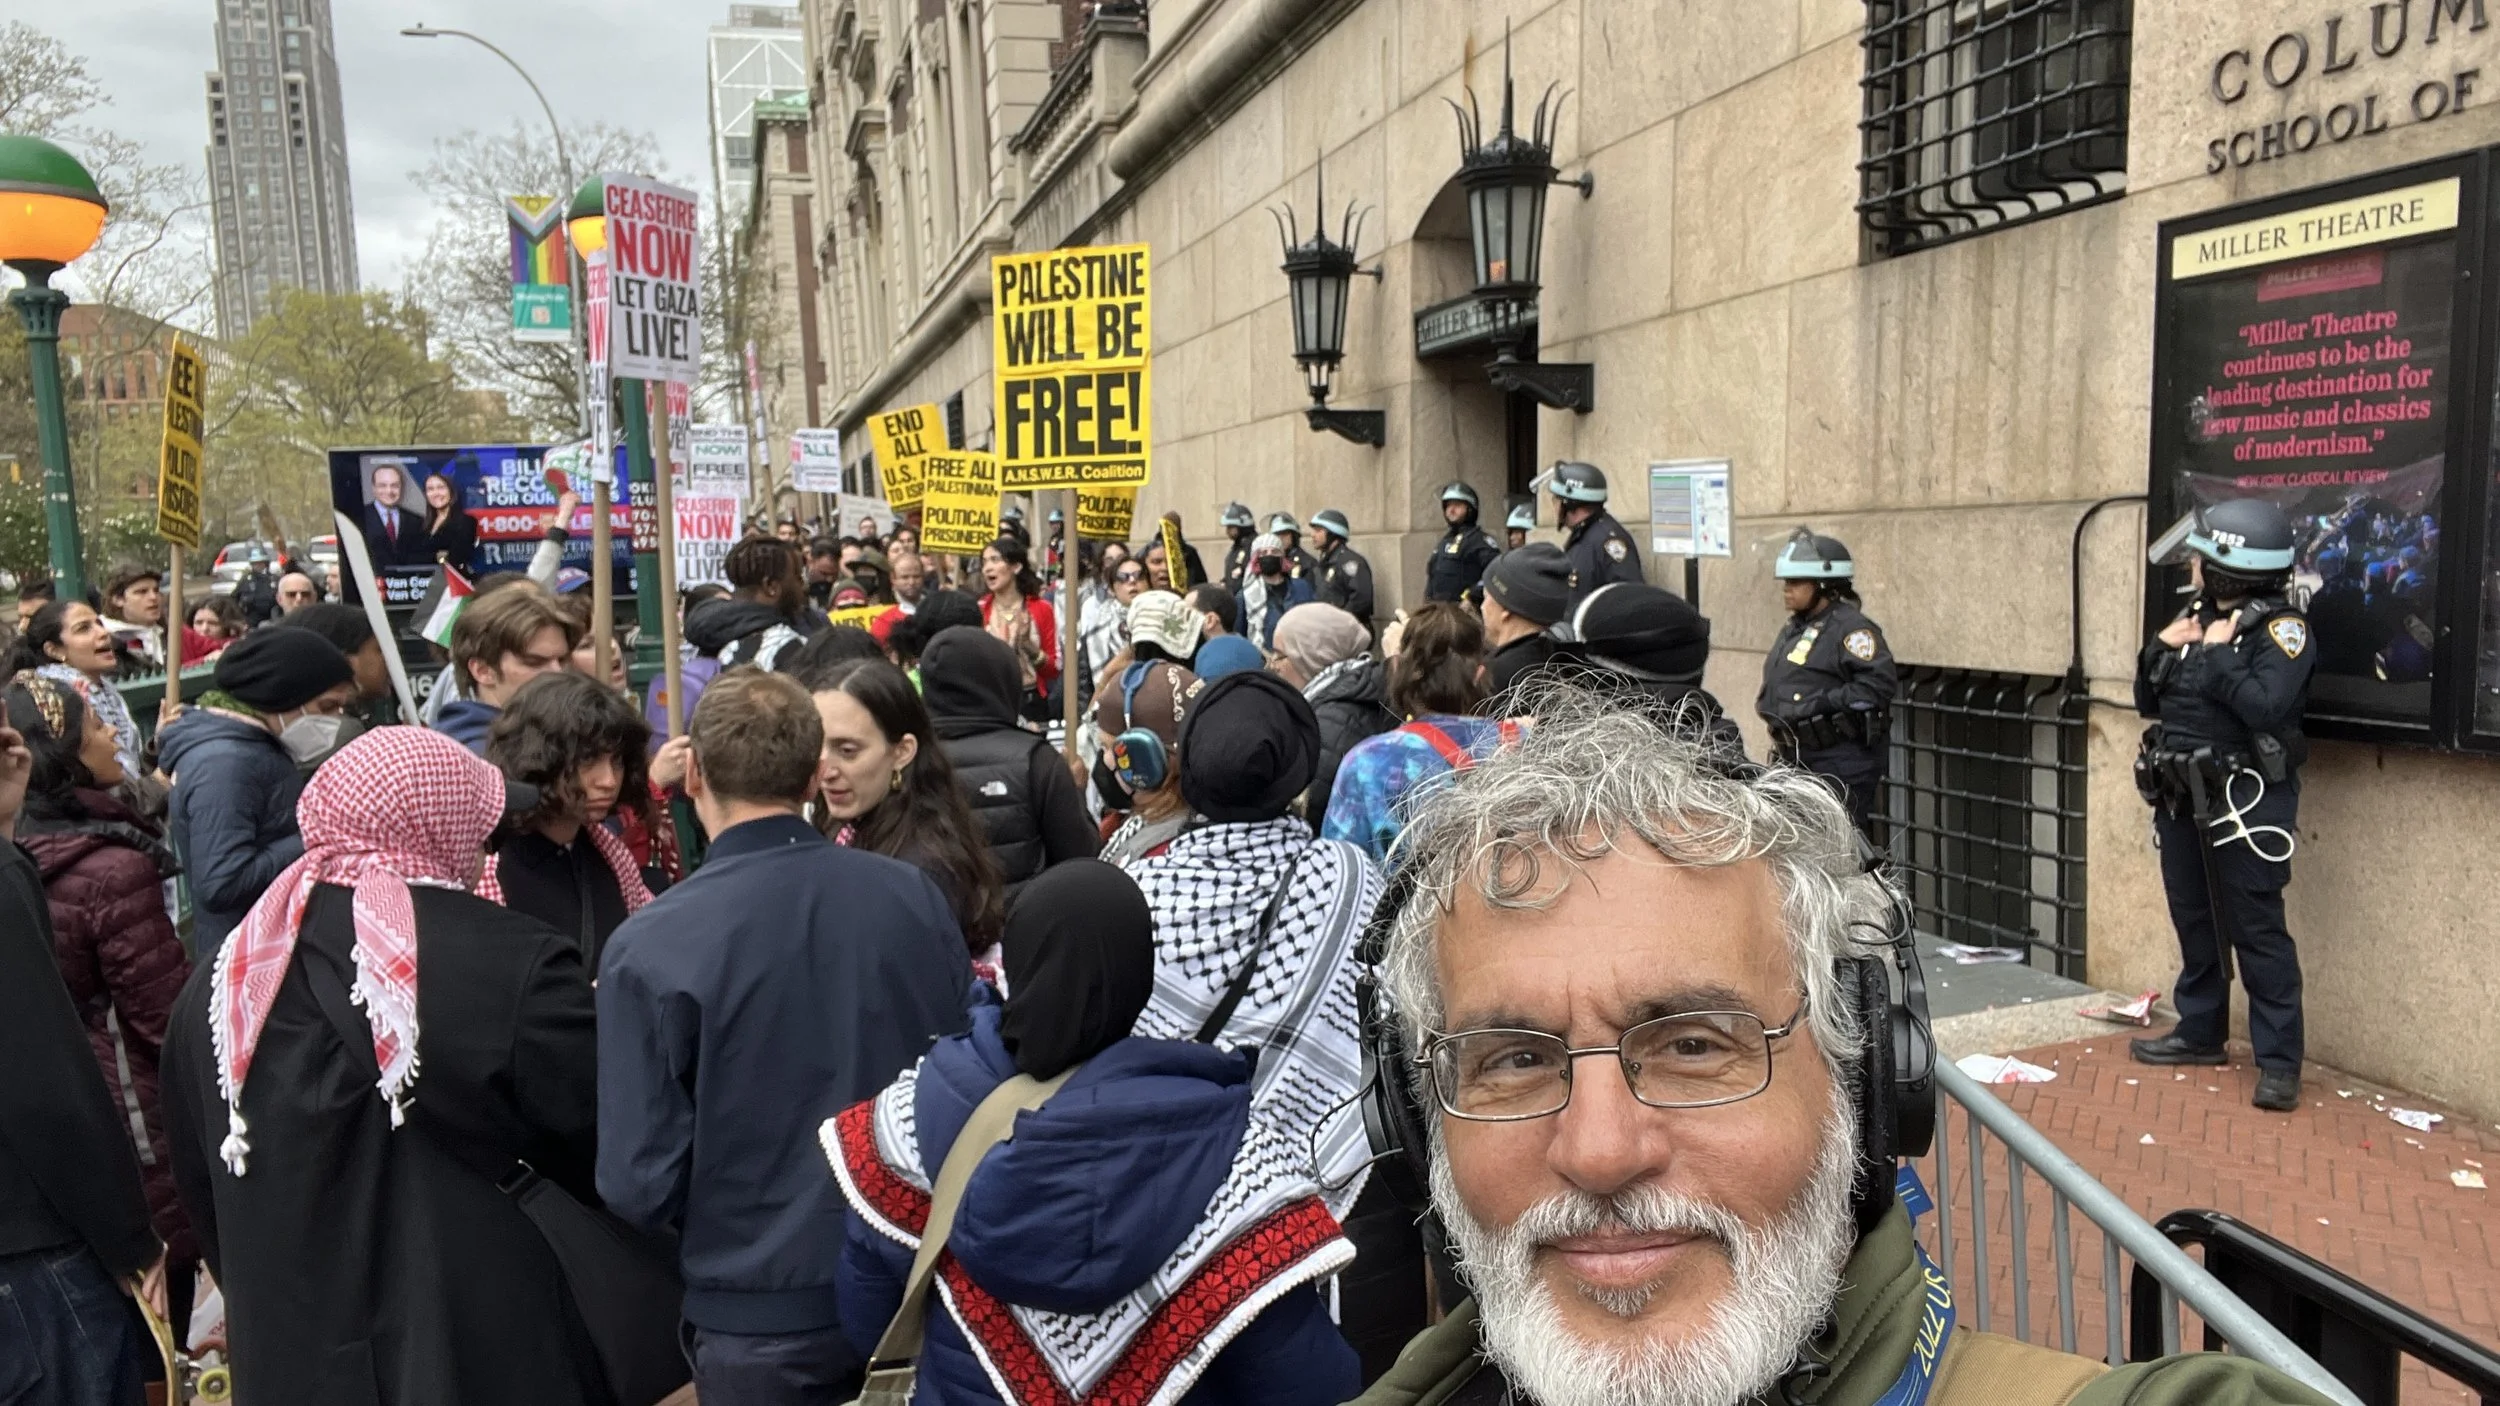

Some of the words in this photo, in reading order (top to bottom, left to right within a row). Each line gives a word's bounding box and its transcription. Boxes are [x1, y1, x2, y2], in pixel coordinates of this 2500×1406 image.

[2211, 0, 2489, 106] COLUM
[2207, 94, 2389, 176] SCHOOL
[2411, 69, 2480, 122] OF
[605, 183, 698, 231] CEASEFIRE
[2198, 226, 2290, 264] MILLER
[2299, 198, 2425, 244] THEATRE
[613, 219, 692, 284] NOW
[999, 251, 1144, 307] PALESTINE
[614, 275, 648, 310] LET
[654, 282, 699, 318] GAZA
[625, 310, 689, 362] LIVE!
[1003, 306, 1085, 367] WILL
[1096, 301, 1143, 360] BE
[2238, 318, 2308, 346] “Miller
[2311, 310, 2398, 338] Theatre
[2223, 350, 2316, 378] continues
[2319, 347, 2341, 366] to
[2344, 340, 2370, 364] be
[2374, 335, 2412, 360] the
[2205, 380, 2273, 407] leading
[2274, 368, 2393, 401] destination
[2397, 363, 2433, 389] for
[883, 408, 924, 438] END
[1003, 371, 1142, 460] FREE!
[2242, 406, 2299, 432] music
[2302, 401, 2340, 426] and
[2342, 395, 2432, 424] classics
[695, 444, 742, 456] NOW!
[894, 433, 928, 460] ALL
[2233, 436, 2256, 461] of
[2255, 428, 2385, 459] modernism.”
[692, 463, 745, 476] FREE
[884, 463, 917, 487] U.S.
[928, 457, 965, 478] FREE
[1004, 465, 1078, 483] A.N.S.W.E.R.
[1081, 463, 1143, 480] Coalition
[2287, 471, 2340, 486] CLASSICAL
[2343, 469, 2389, 483] REVIEW
[487, 492, 519, 506] FOR
[675, 498, 736, 514] CEASEFIRE
[888, 488, 905, 502] TO
[678, 514, 734, 541] NOW
[925, 507, 995, 528] POLITICAL
[678, 541, 699, 558] LET
[924, 527, 995, 546] PRISONERS
[385, 577, 408, 589] Van
[386, 589, 409, 601] Van
[1913, 1302, 1946, 1379] 2022
